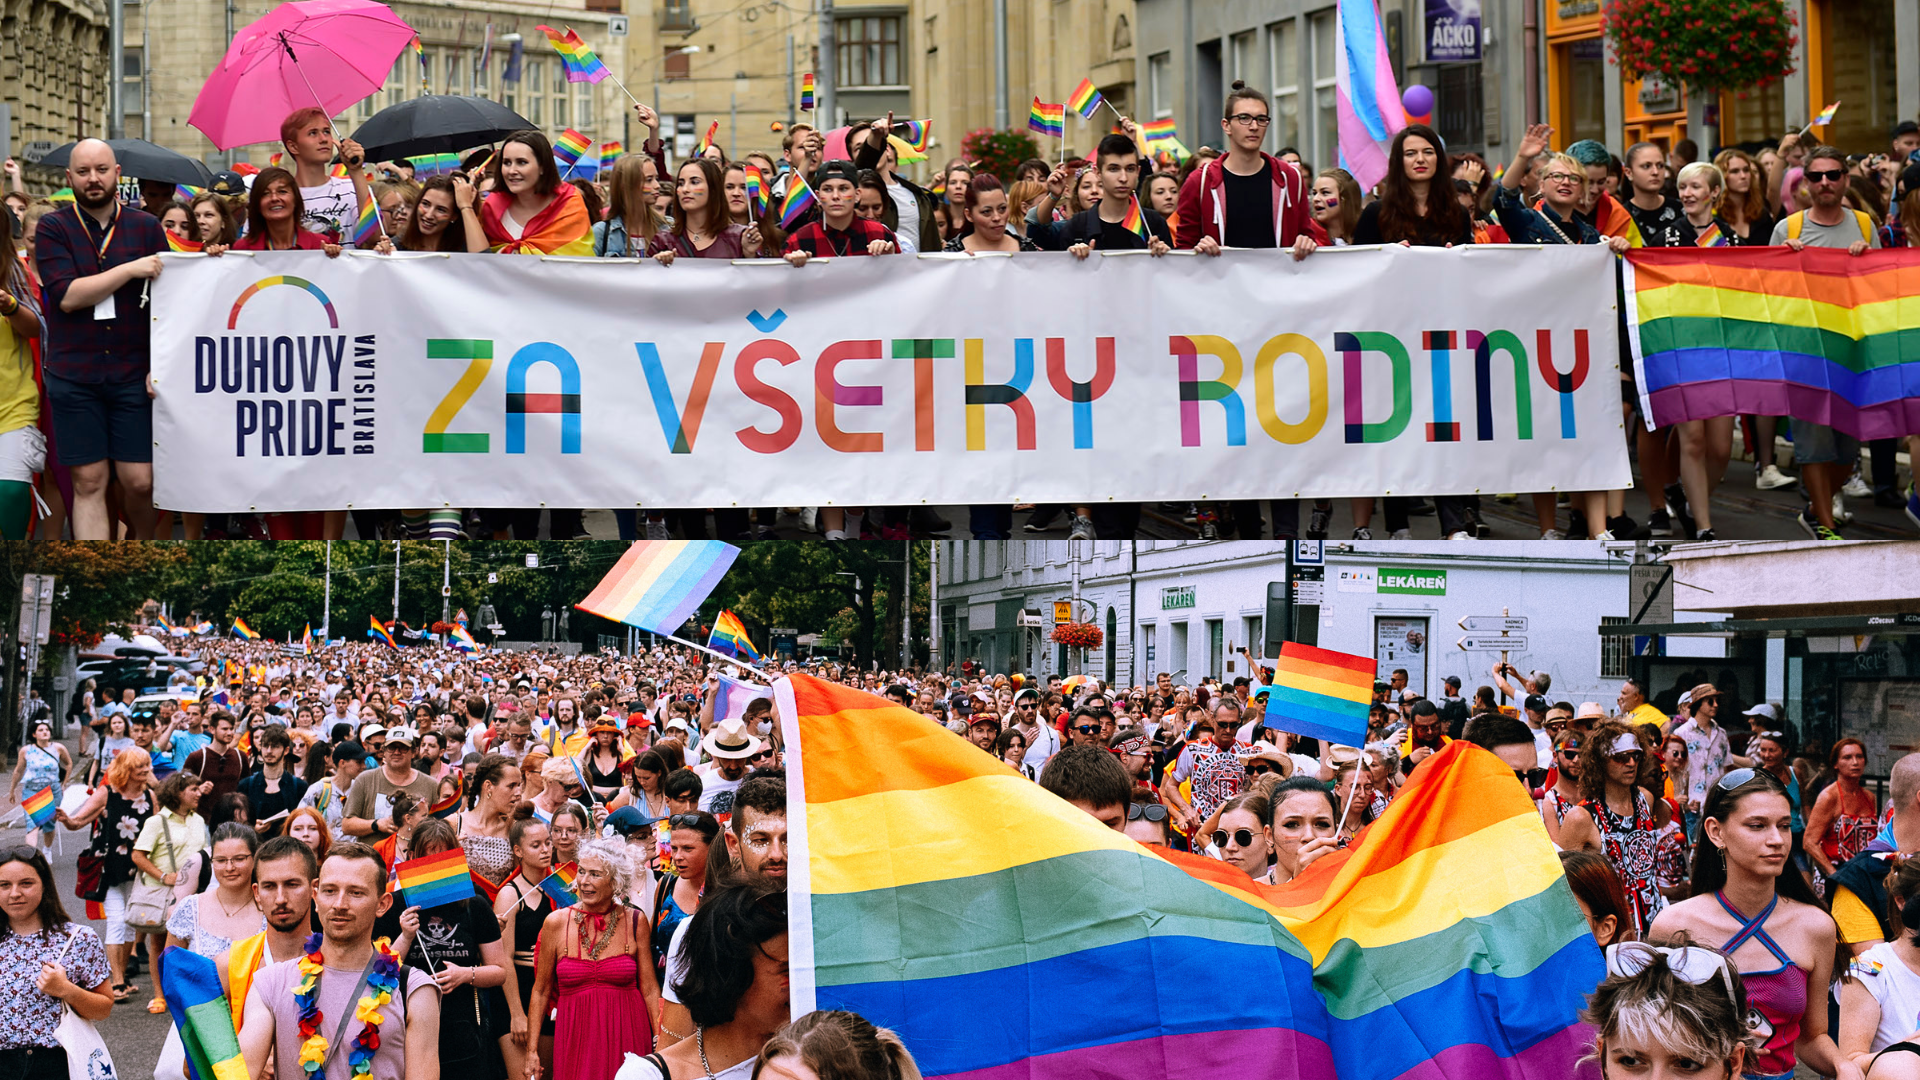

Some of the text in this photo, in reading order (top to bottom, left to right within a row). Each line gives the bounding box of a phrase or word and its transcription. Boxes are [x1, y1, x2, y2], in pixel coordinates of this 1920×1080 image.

[1432, 17, 1475, 48] ÁČKO
[33, 141, 52, 150] KLUB
[194, 335, 347, 394] DUHOVY
[422, 307, 1591, 455] ZA VŠETKY RODINY
[352, 334, 376, 455] BRATISLAVA
[236, 398, 347, 457] PRIDE
[1378, 574, 1446, 590] LEKÁREŇ
[1162, 590, 1195, 609] LEKÁREŇ
[1867, 616, 1895, 625] JCDecaux
[410, 949, 470, 959] SANSIBAR
